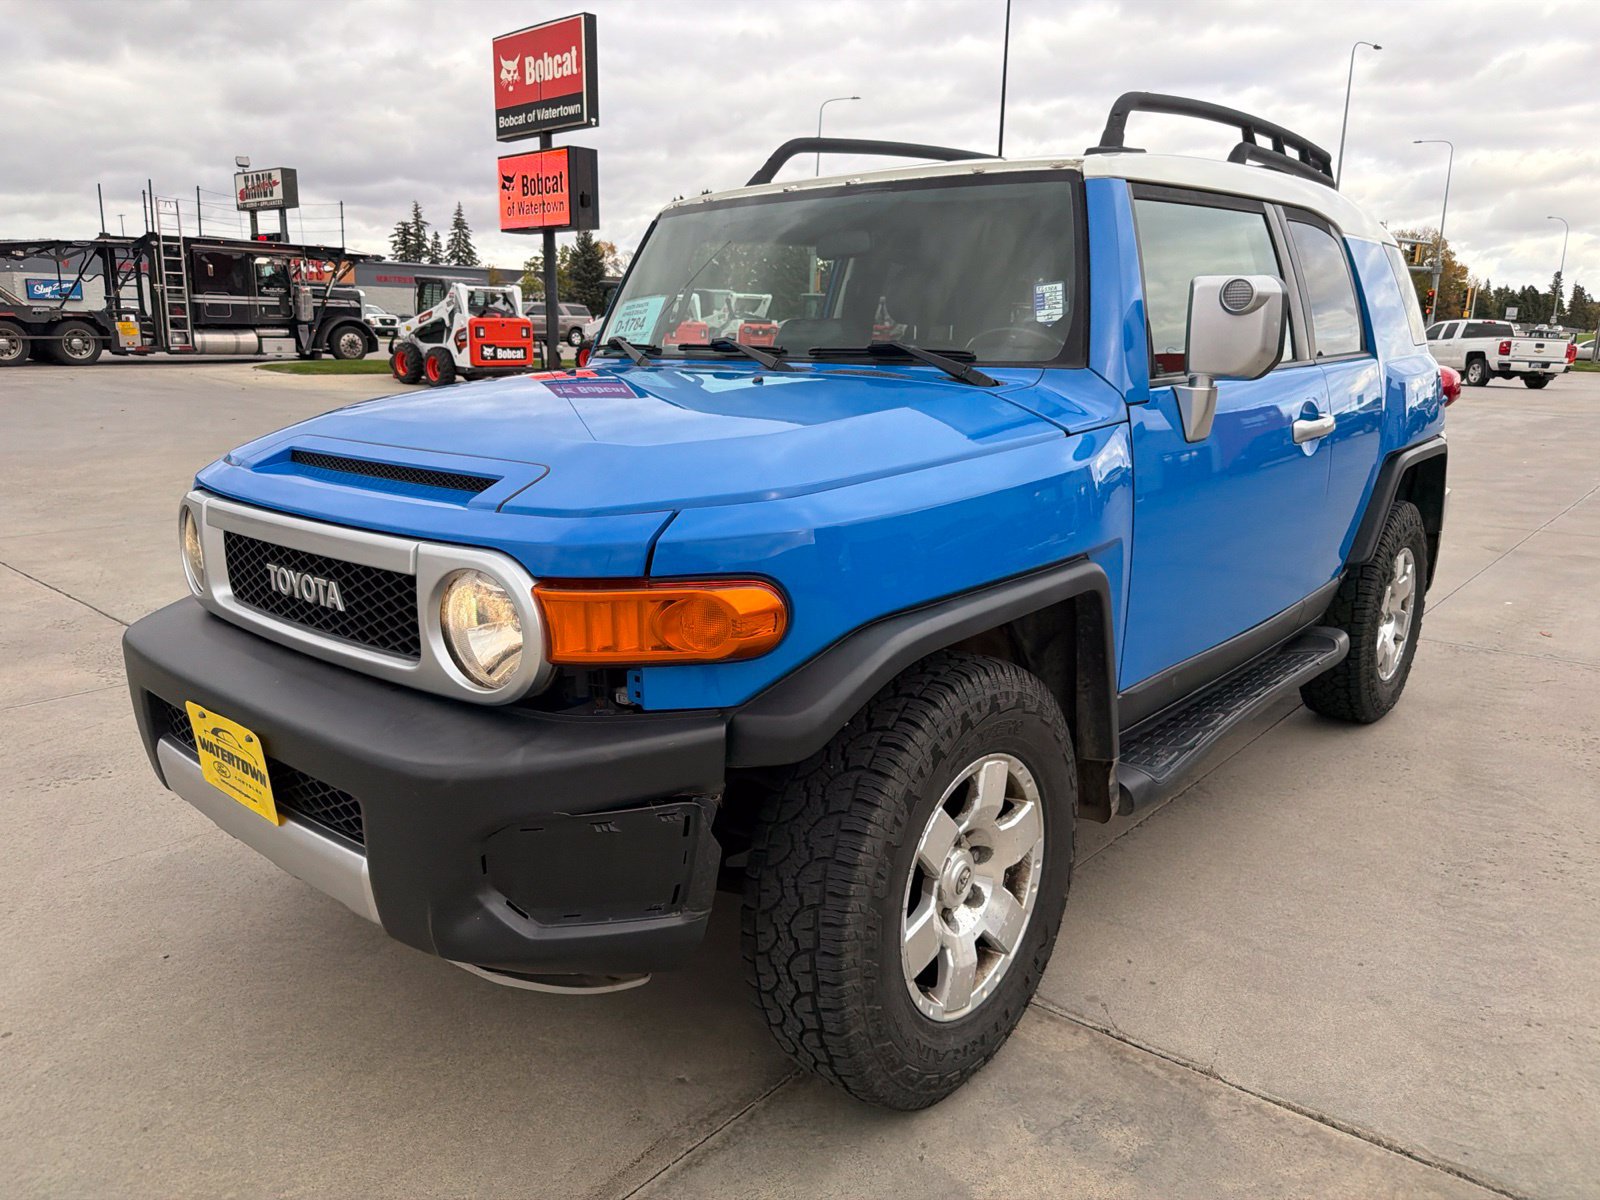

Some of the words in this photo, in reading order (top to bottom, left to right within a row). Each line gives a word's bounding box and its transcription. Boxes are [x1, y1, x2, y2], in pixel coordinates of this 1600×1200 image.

[524, 45, 578, 86] Bobcat
[499, 114, 527, 129] Bobcat
[527, 109, 536, 123] of
[537, 102, 581, 121] Watertown
[521, 171, 564, 197] Bobcat
[507, 203, 515, 217] of
[518, 199, 565, 216] Watertown
[614, 316, 646, 334] D-1784
[496, 348, 525, 360] Bobcat
[266, 562, 346, 613] TOYOTA
[197, 734, 268, 789] WATERTOWN
